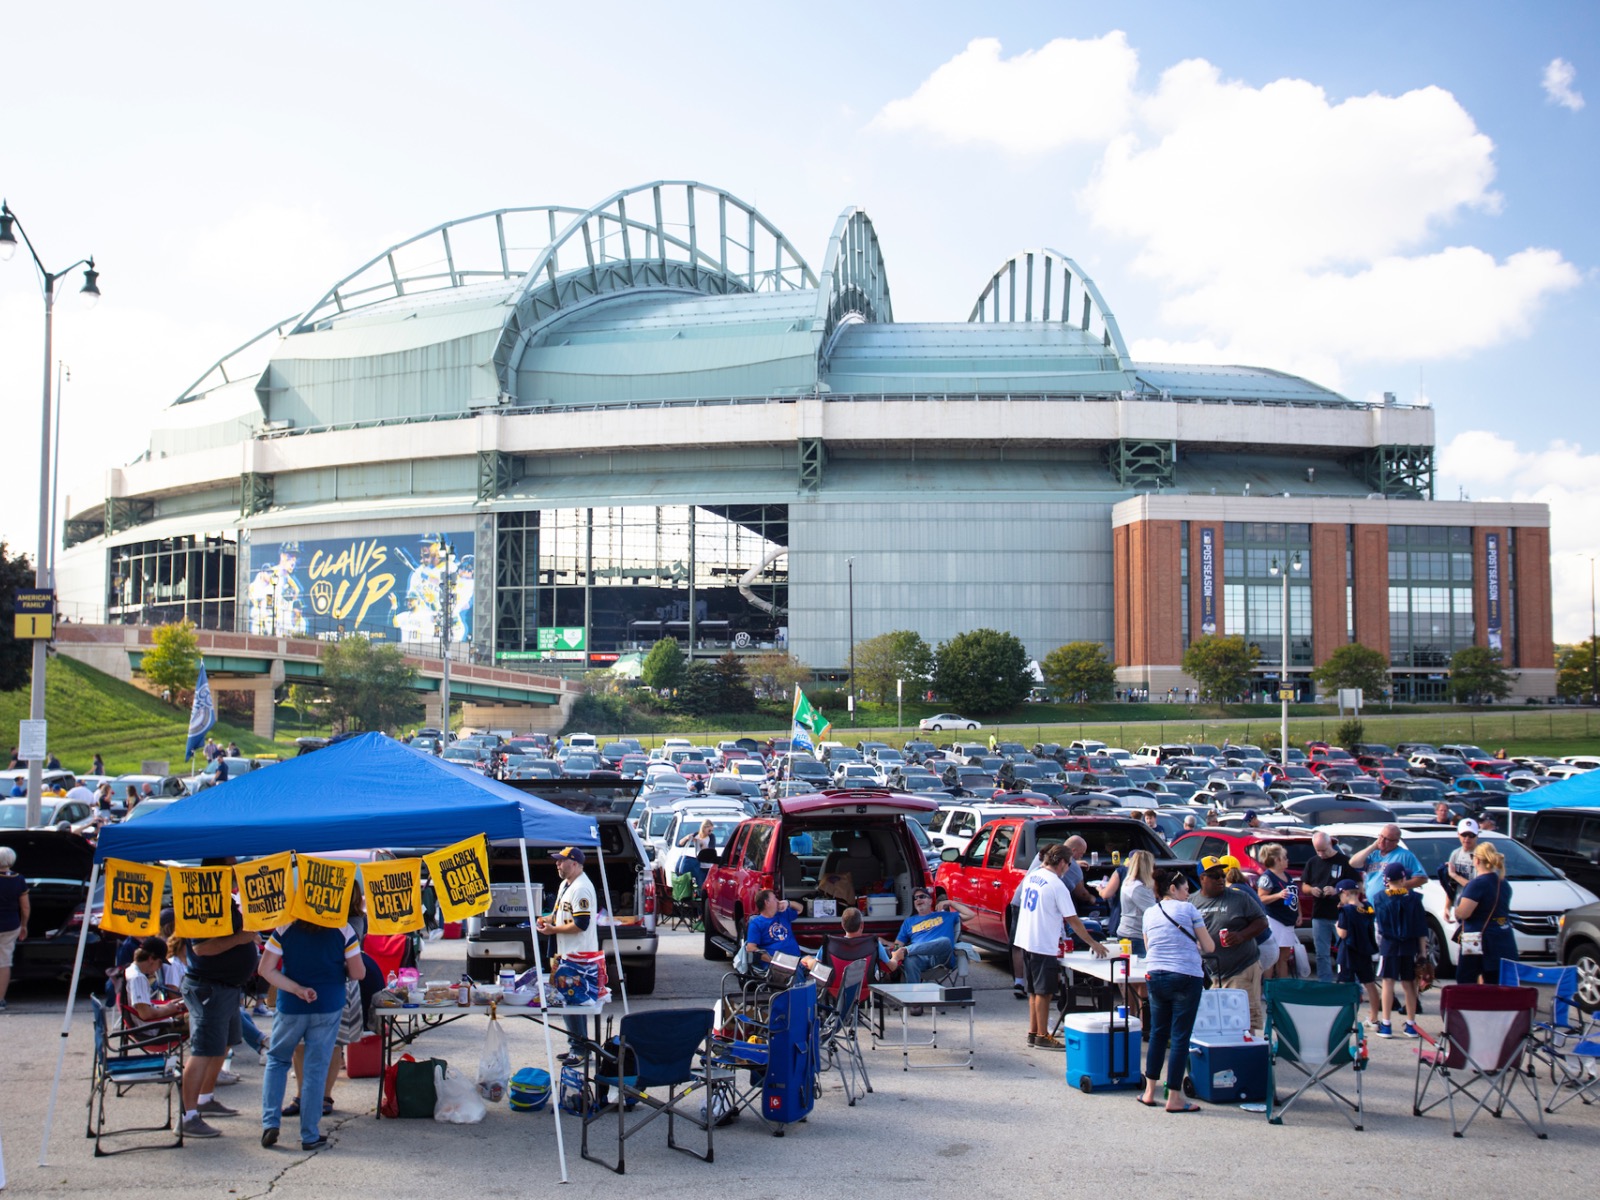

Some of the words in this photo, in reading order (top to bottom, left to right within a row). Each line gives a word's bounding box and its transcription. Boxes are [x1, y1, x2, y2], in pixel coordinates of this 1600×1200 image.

[309, 538, 388, 580] CLAWS
[1203, 544, 1212, 597] POSTSEASON
[1488, 549, 1498, 601] POSTSEASON
[331, 571, 396, 629] UP
[31, 616, 36, 636] 1
[439, 860, 454, 871] OUR
[453, 847, 477, 867] CREW
[180, 872, 198, 884] THIS
[198, 871, 223, 894] MY
[247, 871, 284, 899] CREW
[307, 860, 336, 887] TRUE
[369, 879, 384, 894] ONE
[384, 871, 413, 891] TOUGH
[445, 862, 480, 889] OUR
[118, 881, 149, 904] LET'S
[304, 882, 344, 911] CREW
[450, 880, 488, 902] OCTOBER.
[1024, 887, 1039, 912] 19
[184, 893, 221, 917] CREW
[248, 901, 265, 914] RUNS
[265, 893, 286, 914] DEEP
[374, 892, 412, 915] CREW
[498, 904, 528, 913] Corona
